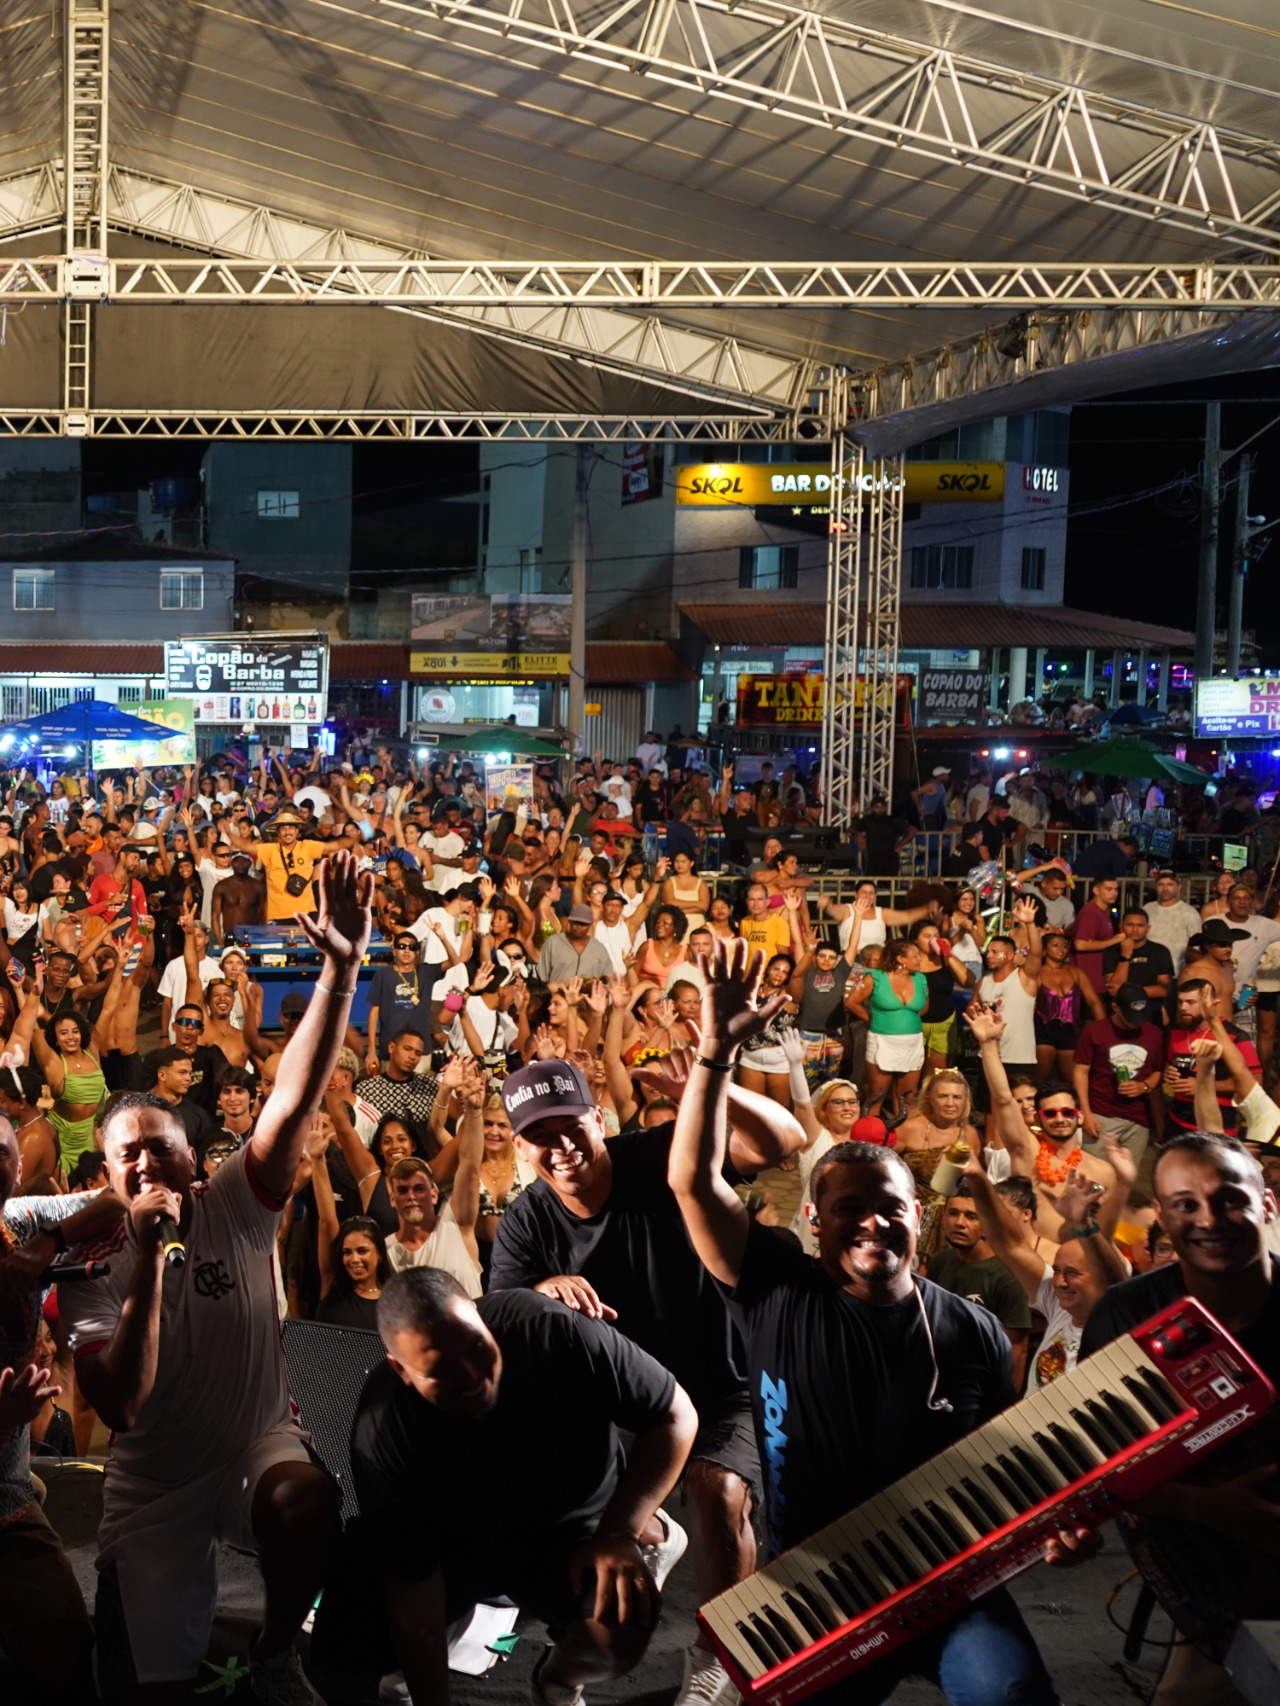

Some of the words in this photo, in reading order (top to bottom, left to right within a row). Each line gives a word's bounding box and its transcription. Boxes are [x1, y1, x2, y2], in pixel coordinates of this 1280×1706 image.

[690, 477, 744, 494] SKOL
[771, 474, 811, 492] BAR
[937, 474, 991, 491] SKOL
[1025, 467, 1058, 492] HOTEL
[191, 648, 254, 667] Copão
[256, 653, 268, 663] do
[423, 661, 446, 669] AQUI
[223, 664, 285, 680] Barba
[965, 674, 983, 690] DO
[925, 691, 979, 708] BARBA
[1245, 720, 1261, 728] Pix
[749, 931, 767, 943] VANS
[505, 1085, 534, 1112] Confia
[535, 1081, 551, 1096] no
[552, 1075, 576, 1095] Pai
[849, 1631, 890, 1660] UMX610
